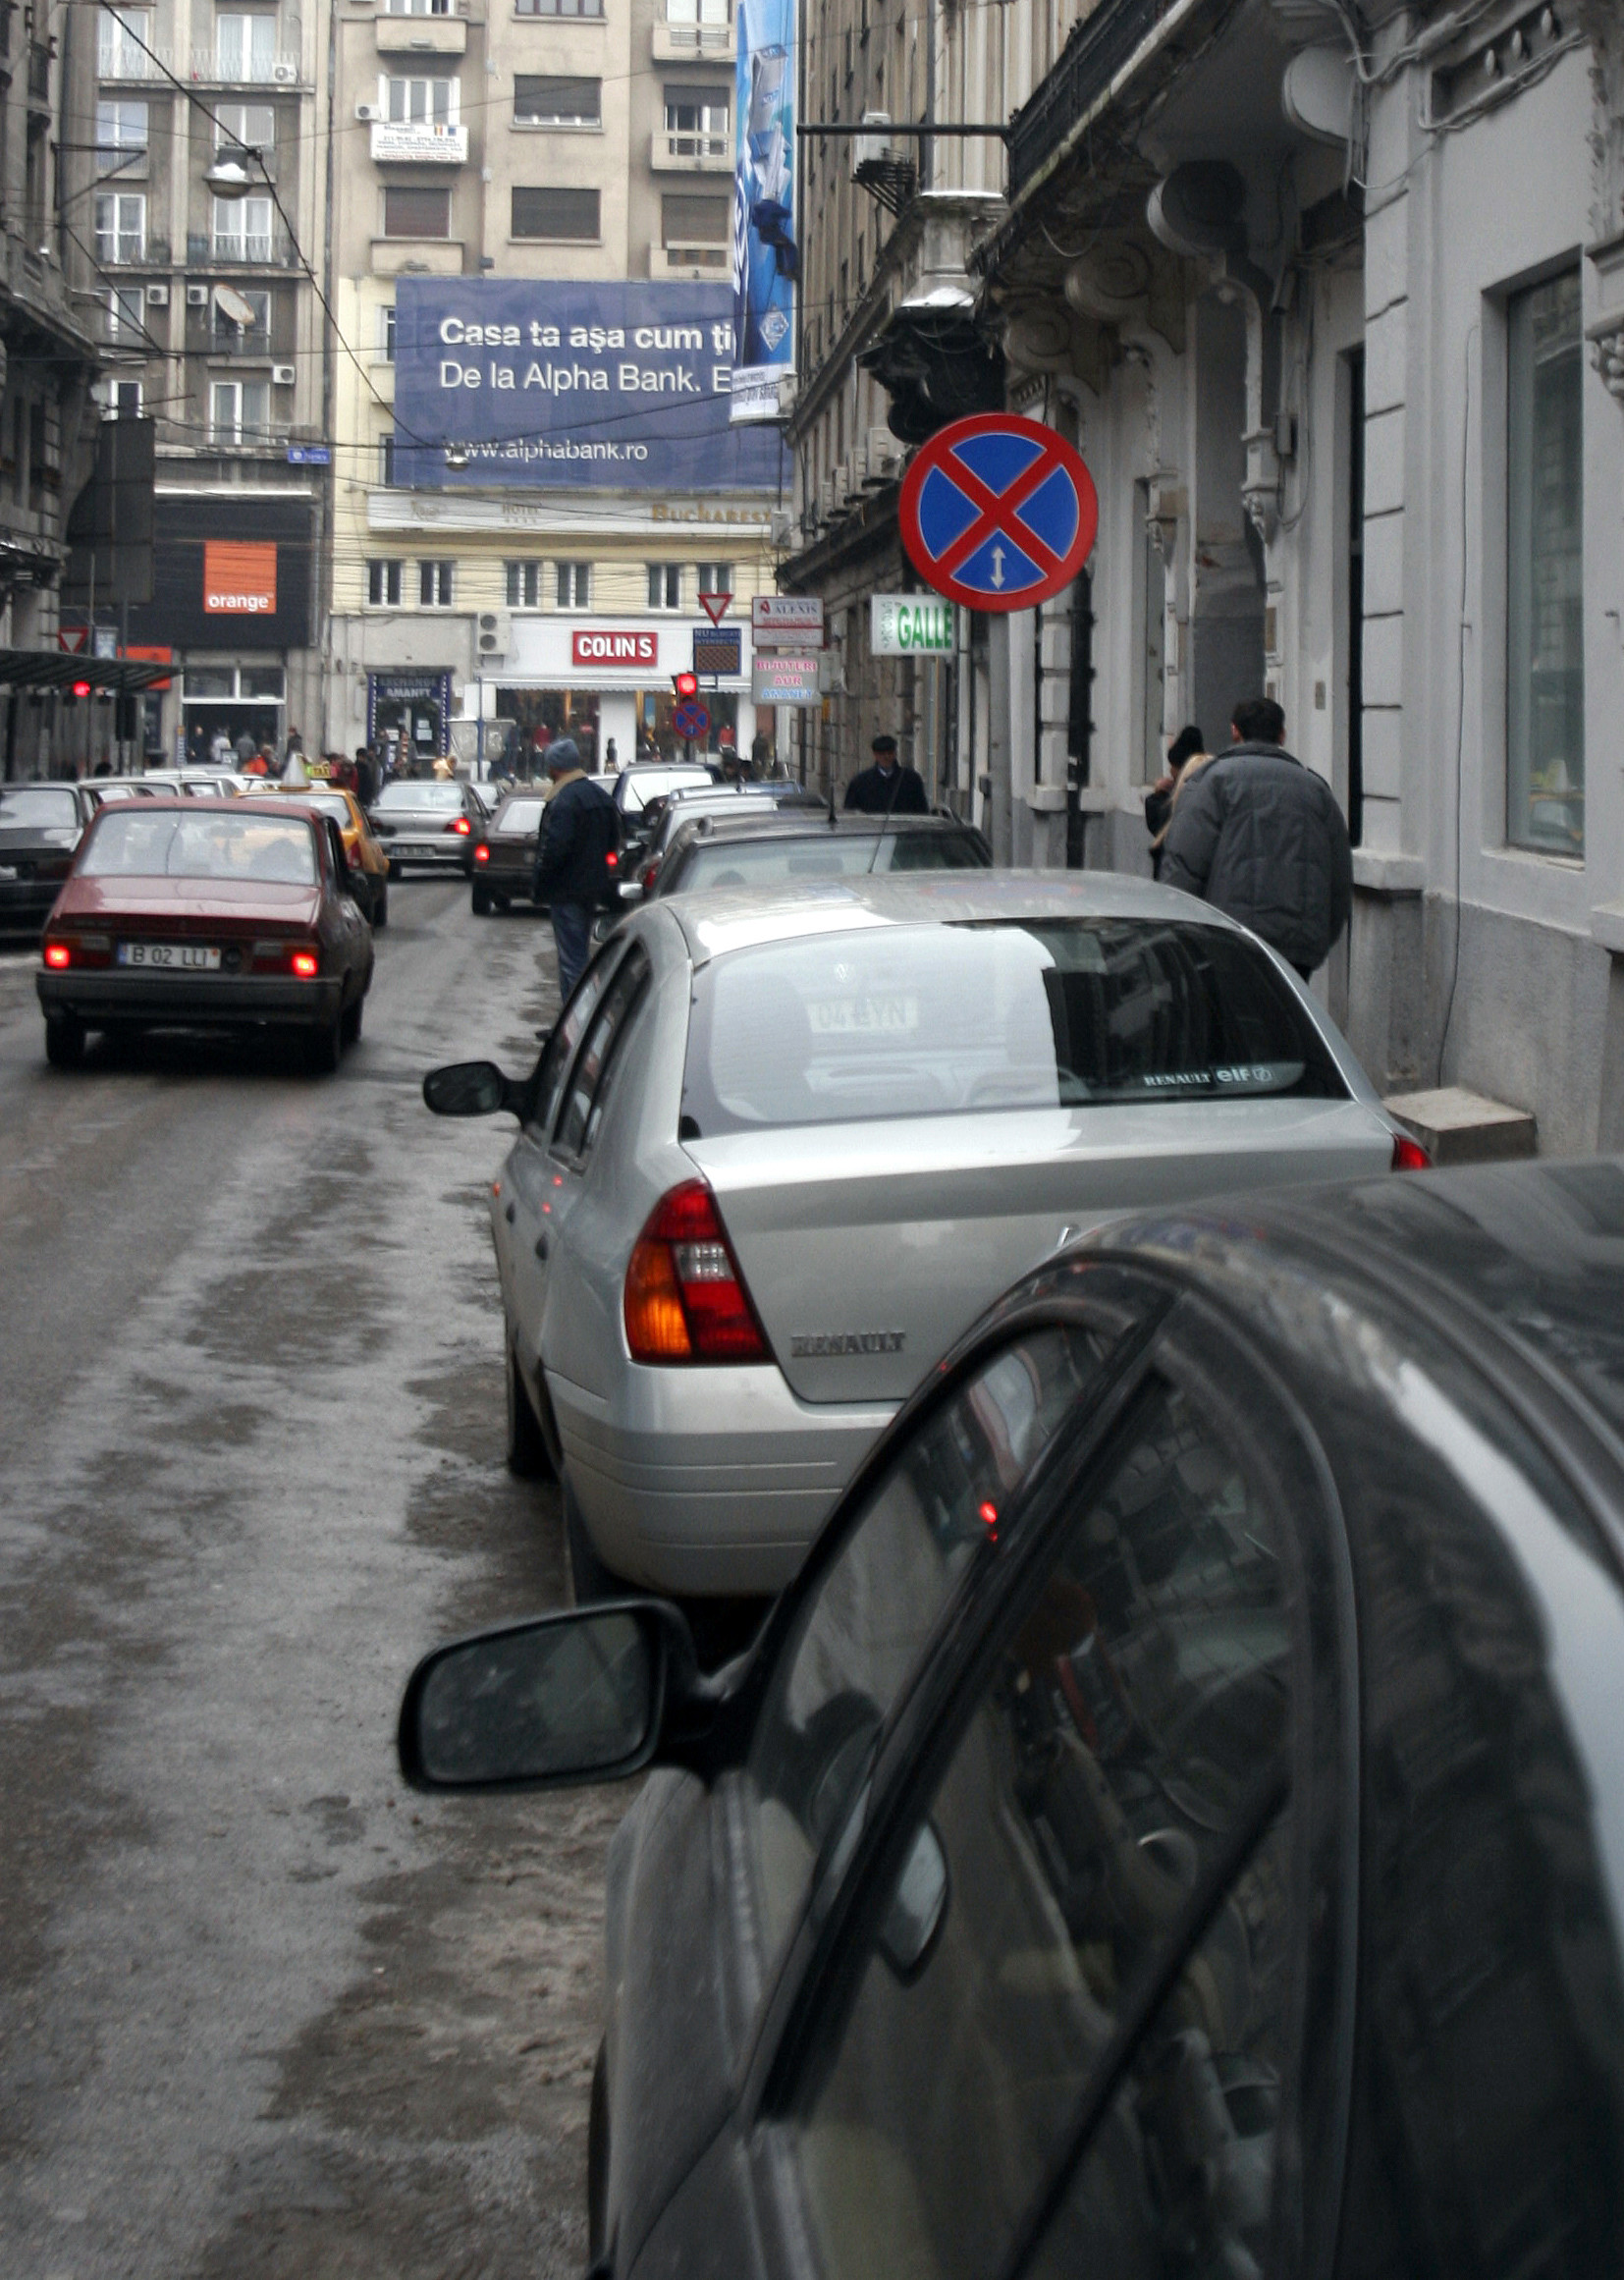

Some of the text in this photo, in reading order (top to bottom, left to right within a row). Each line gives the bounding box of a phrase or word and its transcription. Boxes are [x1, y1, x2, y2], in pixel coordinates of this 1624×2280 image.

[441, 317, 521, 347] Casa
[530, 320, 561, 348] ta
[635, 327, 703, 351] cum
[441, 360, 481, 389] De
[491, 362, 515, 390] la
[524, 362, 610, 396] Alpha
[620, 364, 702, 393] Bank.
[208, 595, 269, 612] orange
[152, 948, 172, 964] 02
[1144, 1068, 1250, 1086] RENAULT elf
[791, 1330, 905, 1357] RENAULT
